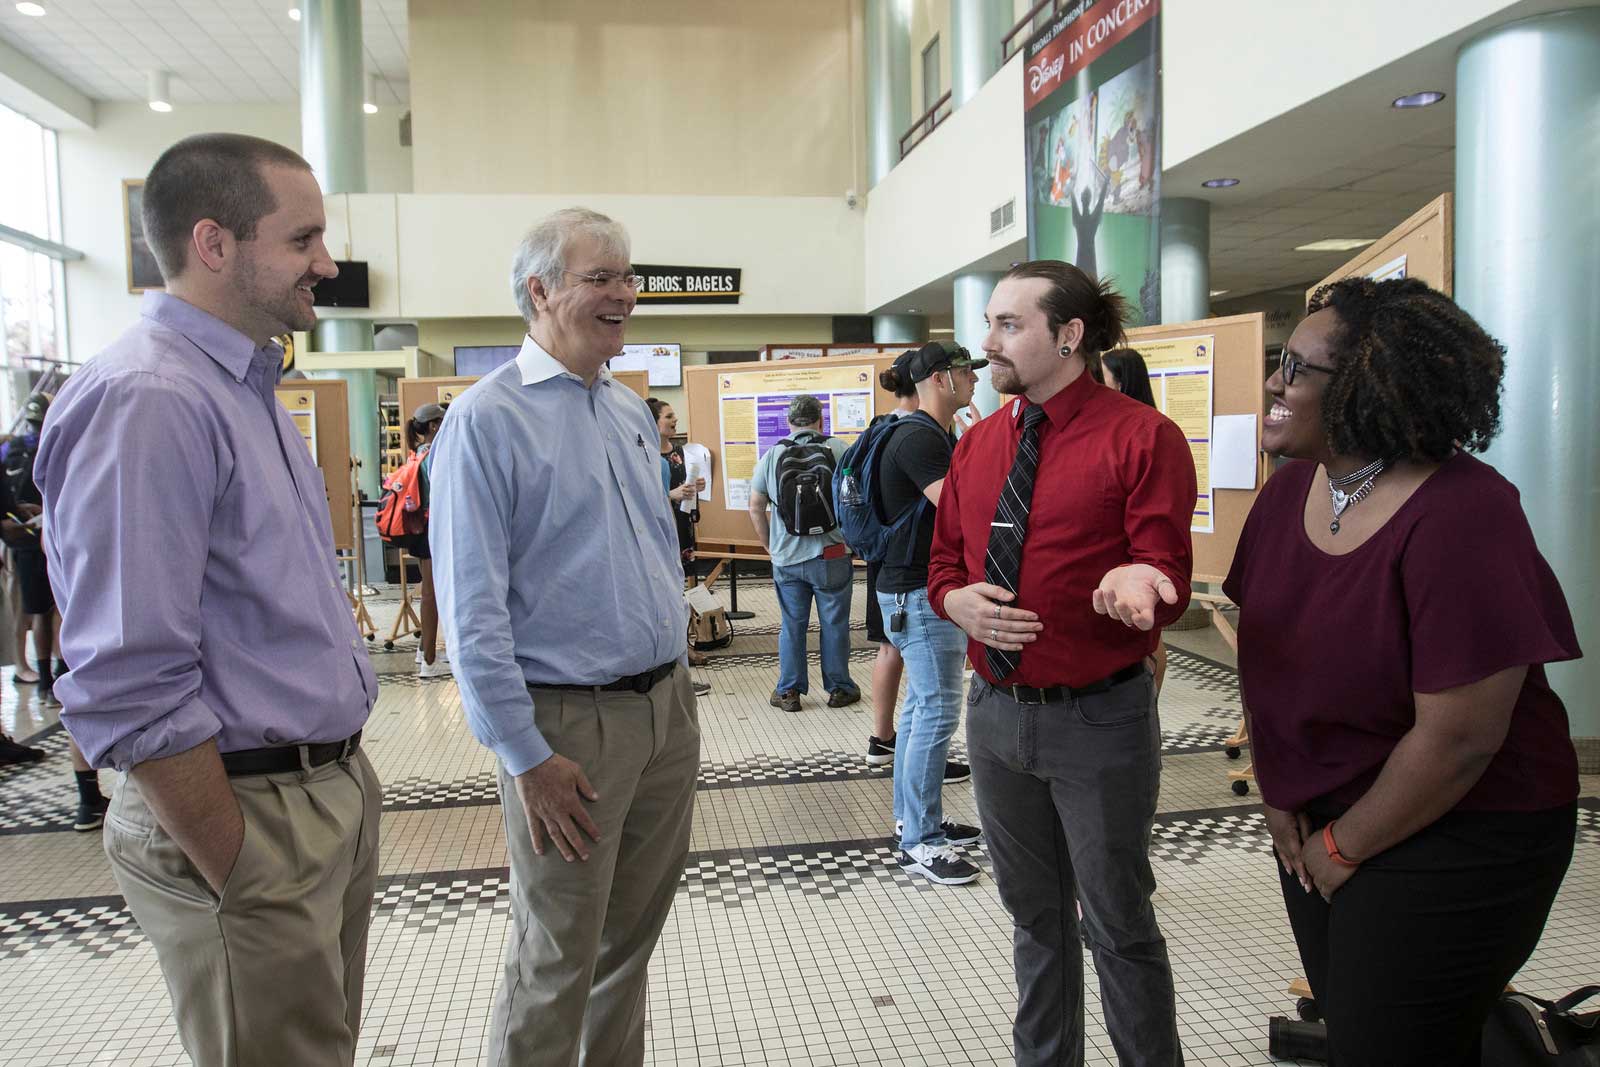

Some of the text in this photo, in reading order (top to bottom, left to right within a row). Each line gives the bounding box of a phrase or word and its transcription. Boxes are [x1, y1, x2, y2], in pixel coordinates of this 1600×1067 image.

[1031, 31, 1052, 56] SHOALS
[1052, 1, 1084, 38] SYMPHONY
[1069, 35, 1084, 64] IN
[648, 275, 683, 292] BROS.
[686, 275, 733, 291] BAGELS
